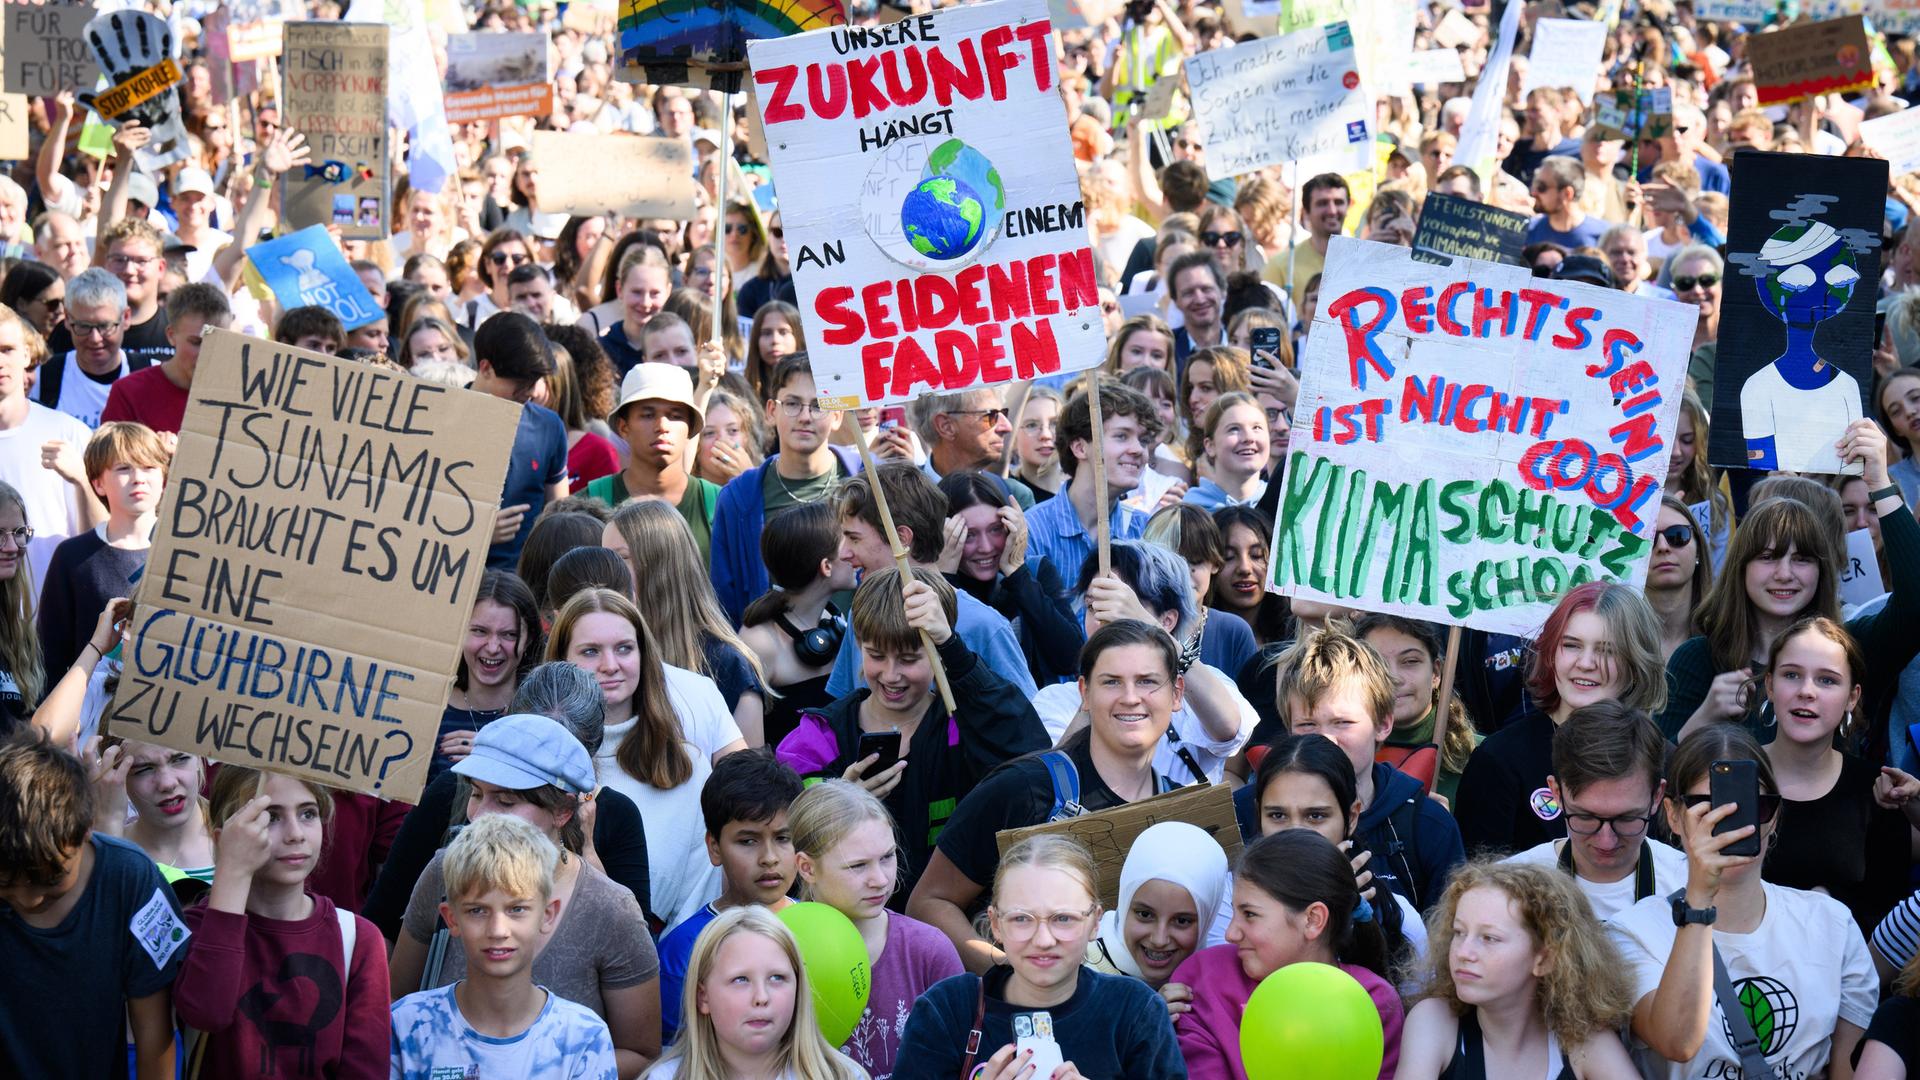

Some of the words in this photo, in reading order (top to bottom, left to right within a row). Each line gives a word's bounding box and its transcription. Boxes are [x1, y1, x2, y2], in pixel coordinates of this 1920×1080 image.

[16, 10, 61, 35] FÜR
[830, 15, 940, 55] UNSERE
[100, 90, 131, 116] STOP
[134, 65, 174, 99] KOHLE
[288, 49, 343, 71] FISCH
[754, 20, 1052, 125] ZUKUNFT
[1190, 57, 1223, 88] Ich
[1233, 43, 1287, 74] mache
[1198, 84, 1265, 115] Sorgen
[1272, 78, 1298, 93] um
[1306, 65, 1331, 84] die
[860, 109, 954, 152] HÄNGT
[1206, 108, 1281, 146] Zukunft
[1290, 95, 1347, 127] meiner
[796, 239, 846, 271] AN
[1006, 201, 1084, 238] EINEM
[1431, 195, 1526, 233] FEHLSTUNDEN
[300, 282, 340, 306] NOT
[814, 247, 1100, 346] SEIDENEN
[242, 344, 326, 417] WIE
[334, 366, 446, 436] VIELE
[861, 318, 1062, 401] FADEN
[1313, 398, 1393, 445] IST
[1400, 374, 1570, 440] NICHT
[196, 399, 476, 537] TSUNAMIS
[1517, 437, 1659, 534] COOL
[171, 477, 346, 566] BRAUCHT
[343, 519, 402, 582] ES
[411, 537, 471, 605] UM
[161, 549, 283, 626] EINE
[133, 608, 416, 725] GLÜHBIRNE
[111, 678, 182, 736] ZU
[195, 695, 414, 790] WECHSELN?
